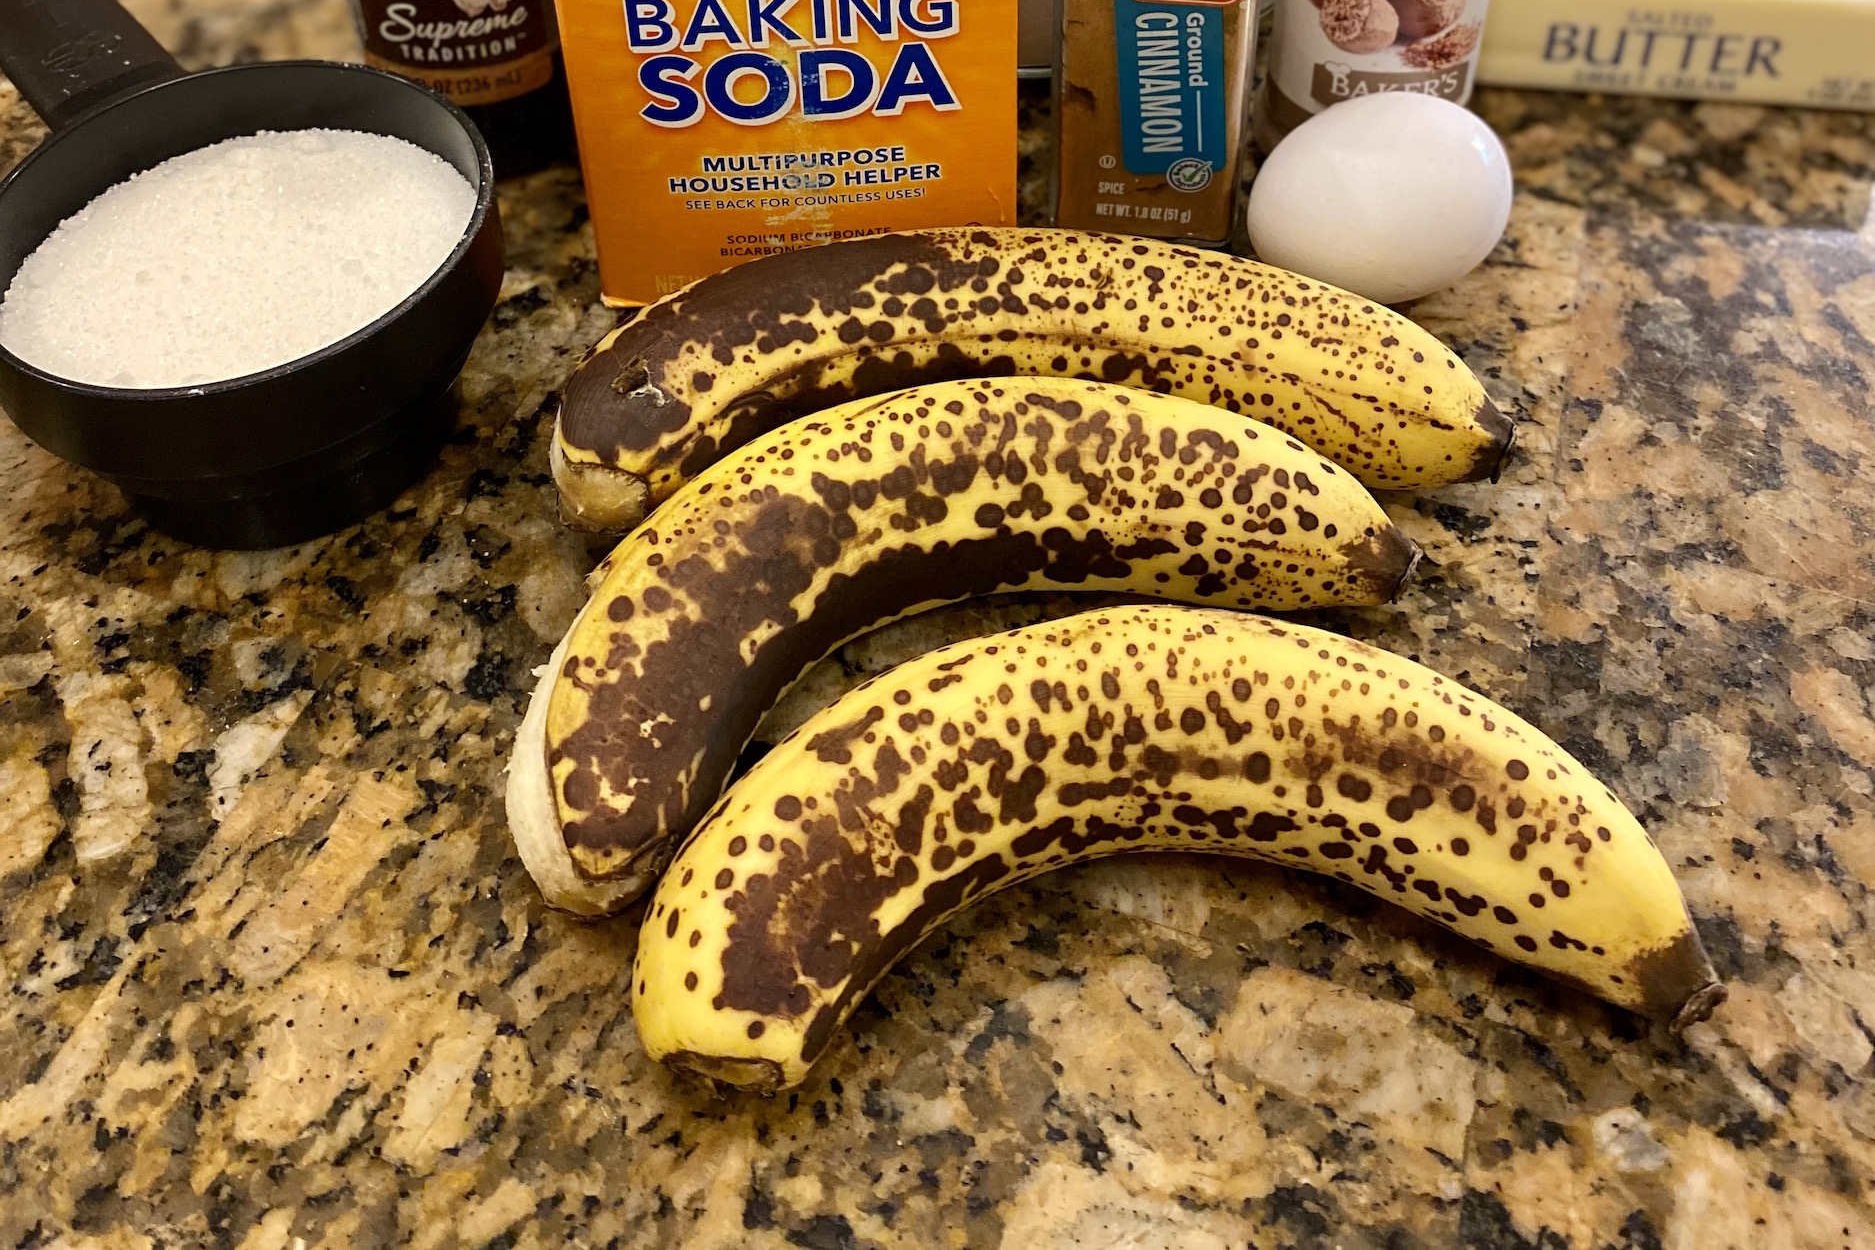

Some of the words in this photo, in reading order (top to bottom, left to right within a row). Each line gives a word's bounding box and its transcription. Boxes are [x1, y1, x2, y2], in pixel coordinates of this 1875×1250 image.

[380, 3, 528, 48] Supreme
[401, 36, 516, 61] TRADITION
[1186, 13, 1208, 86] Ground
[1543, 22, 1782, 78] BUTTER
[638, 42, 962, 128] SODA
[1135, 12, 1184, 153] CINNAMON
[703, 147, 905, 171] MULTIPURPOSE
[669, 173, 836, 193] HOUSEHOLD
[844, 164, 942, 186] HELPER
[1099, 182, 1125, 194] SPICE
[686, 200, 711, 210] SEE
[716, 199, 756, 209] BACK
[761, 198, 790, 208] FOR
[794, 192, 881, 207] COUNTLESS
[886, 187, 926, 199] USES!
[1096, 203, 1114, 215] NET
[1116, 205, 1131, 217] WT.
[1135, 207, 1148, 218] 1.8
[1150, 208, 1162, 219] OZ
[1164, 208, 1178, 221] (51
[727, 234, 785, 244] SODIUM
